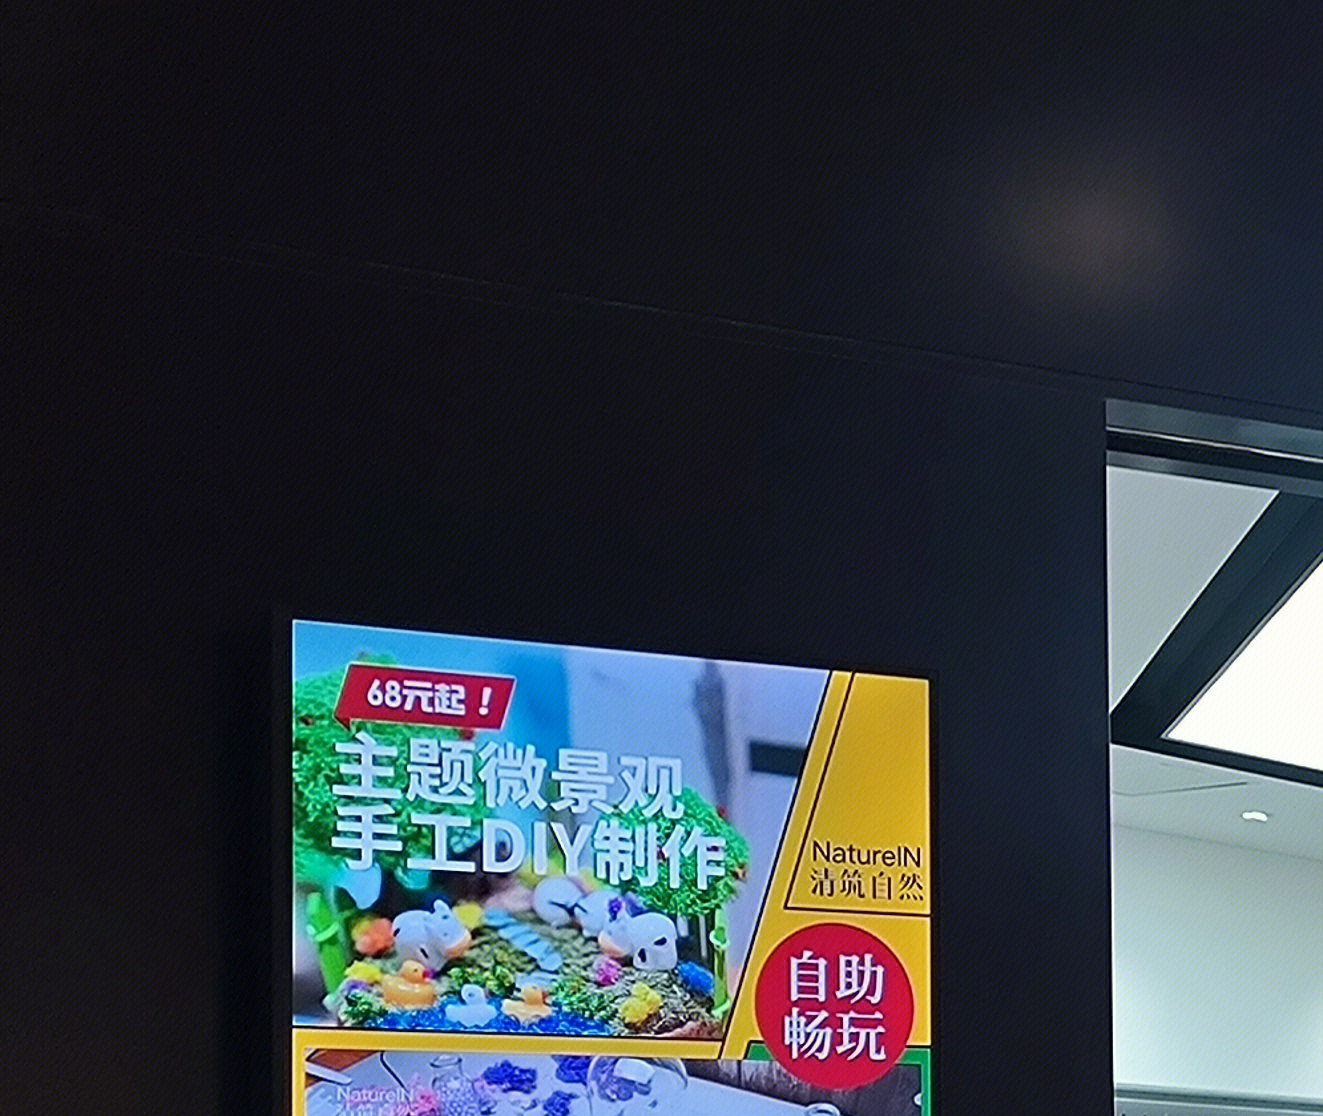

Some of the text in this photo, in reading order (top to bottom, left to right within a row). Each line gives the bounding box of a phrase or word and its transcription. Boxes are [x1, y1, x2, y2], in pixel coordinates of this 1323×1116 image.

[331, 731, 685, 820] 主题微景观
[330, 803, 728, 891] 手工DIY制作
[812, 839, 921, 868] NatureIN
[810, 867, 924, 901] 清筑自然
[788, 950, 885, 1005] 自助
[783, 1009, 887, 1061] 畅玩
